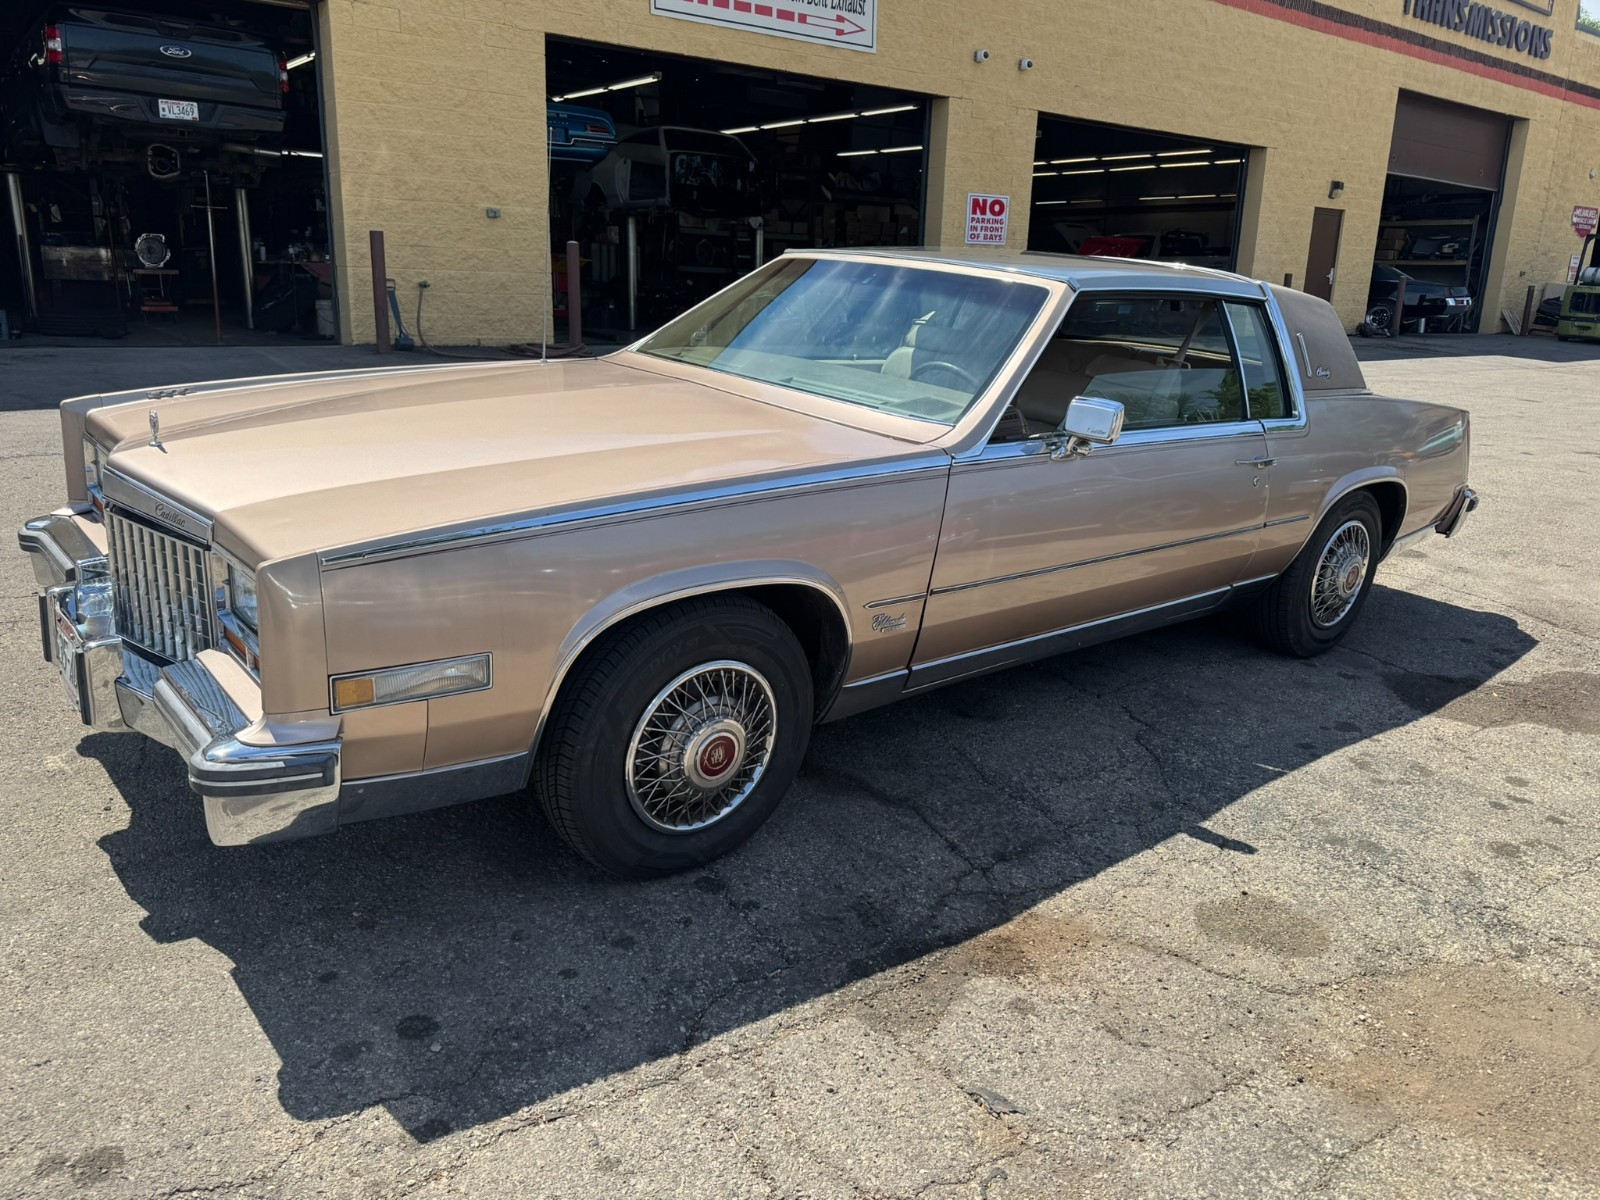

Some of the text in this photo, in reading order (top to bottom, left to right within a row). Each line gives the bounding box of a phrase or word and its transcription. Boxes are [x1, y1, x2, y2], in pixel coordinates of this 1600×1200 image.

[830, 0, 866, 16] Exhaust
[167, 47, 185, 56] Ford
[167, 104, 195, 117] VL3469
[971, 197, 1005, 217] NO
[970, 216, 1004, 225] PARKING
[970, 224, 1003, 233] IN FRONT
[983, 233, 1003, 241] BAYS
[155, 503, 186, 528] Cadillac
